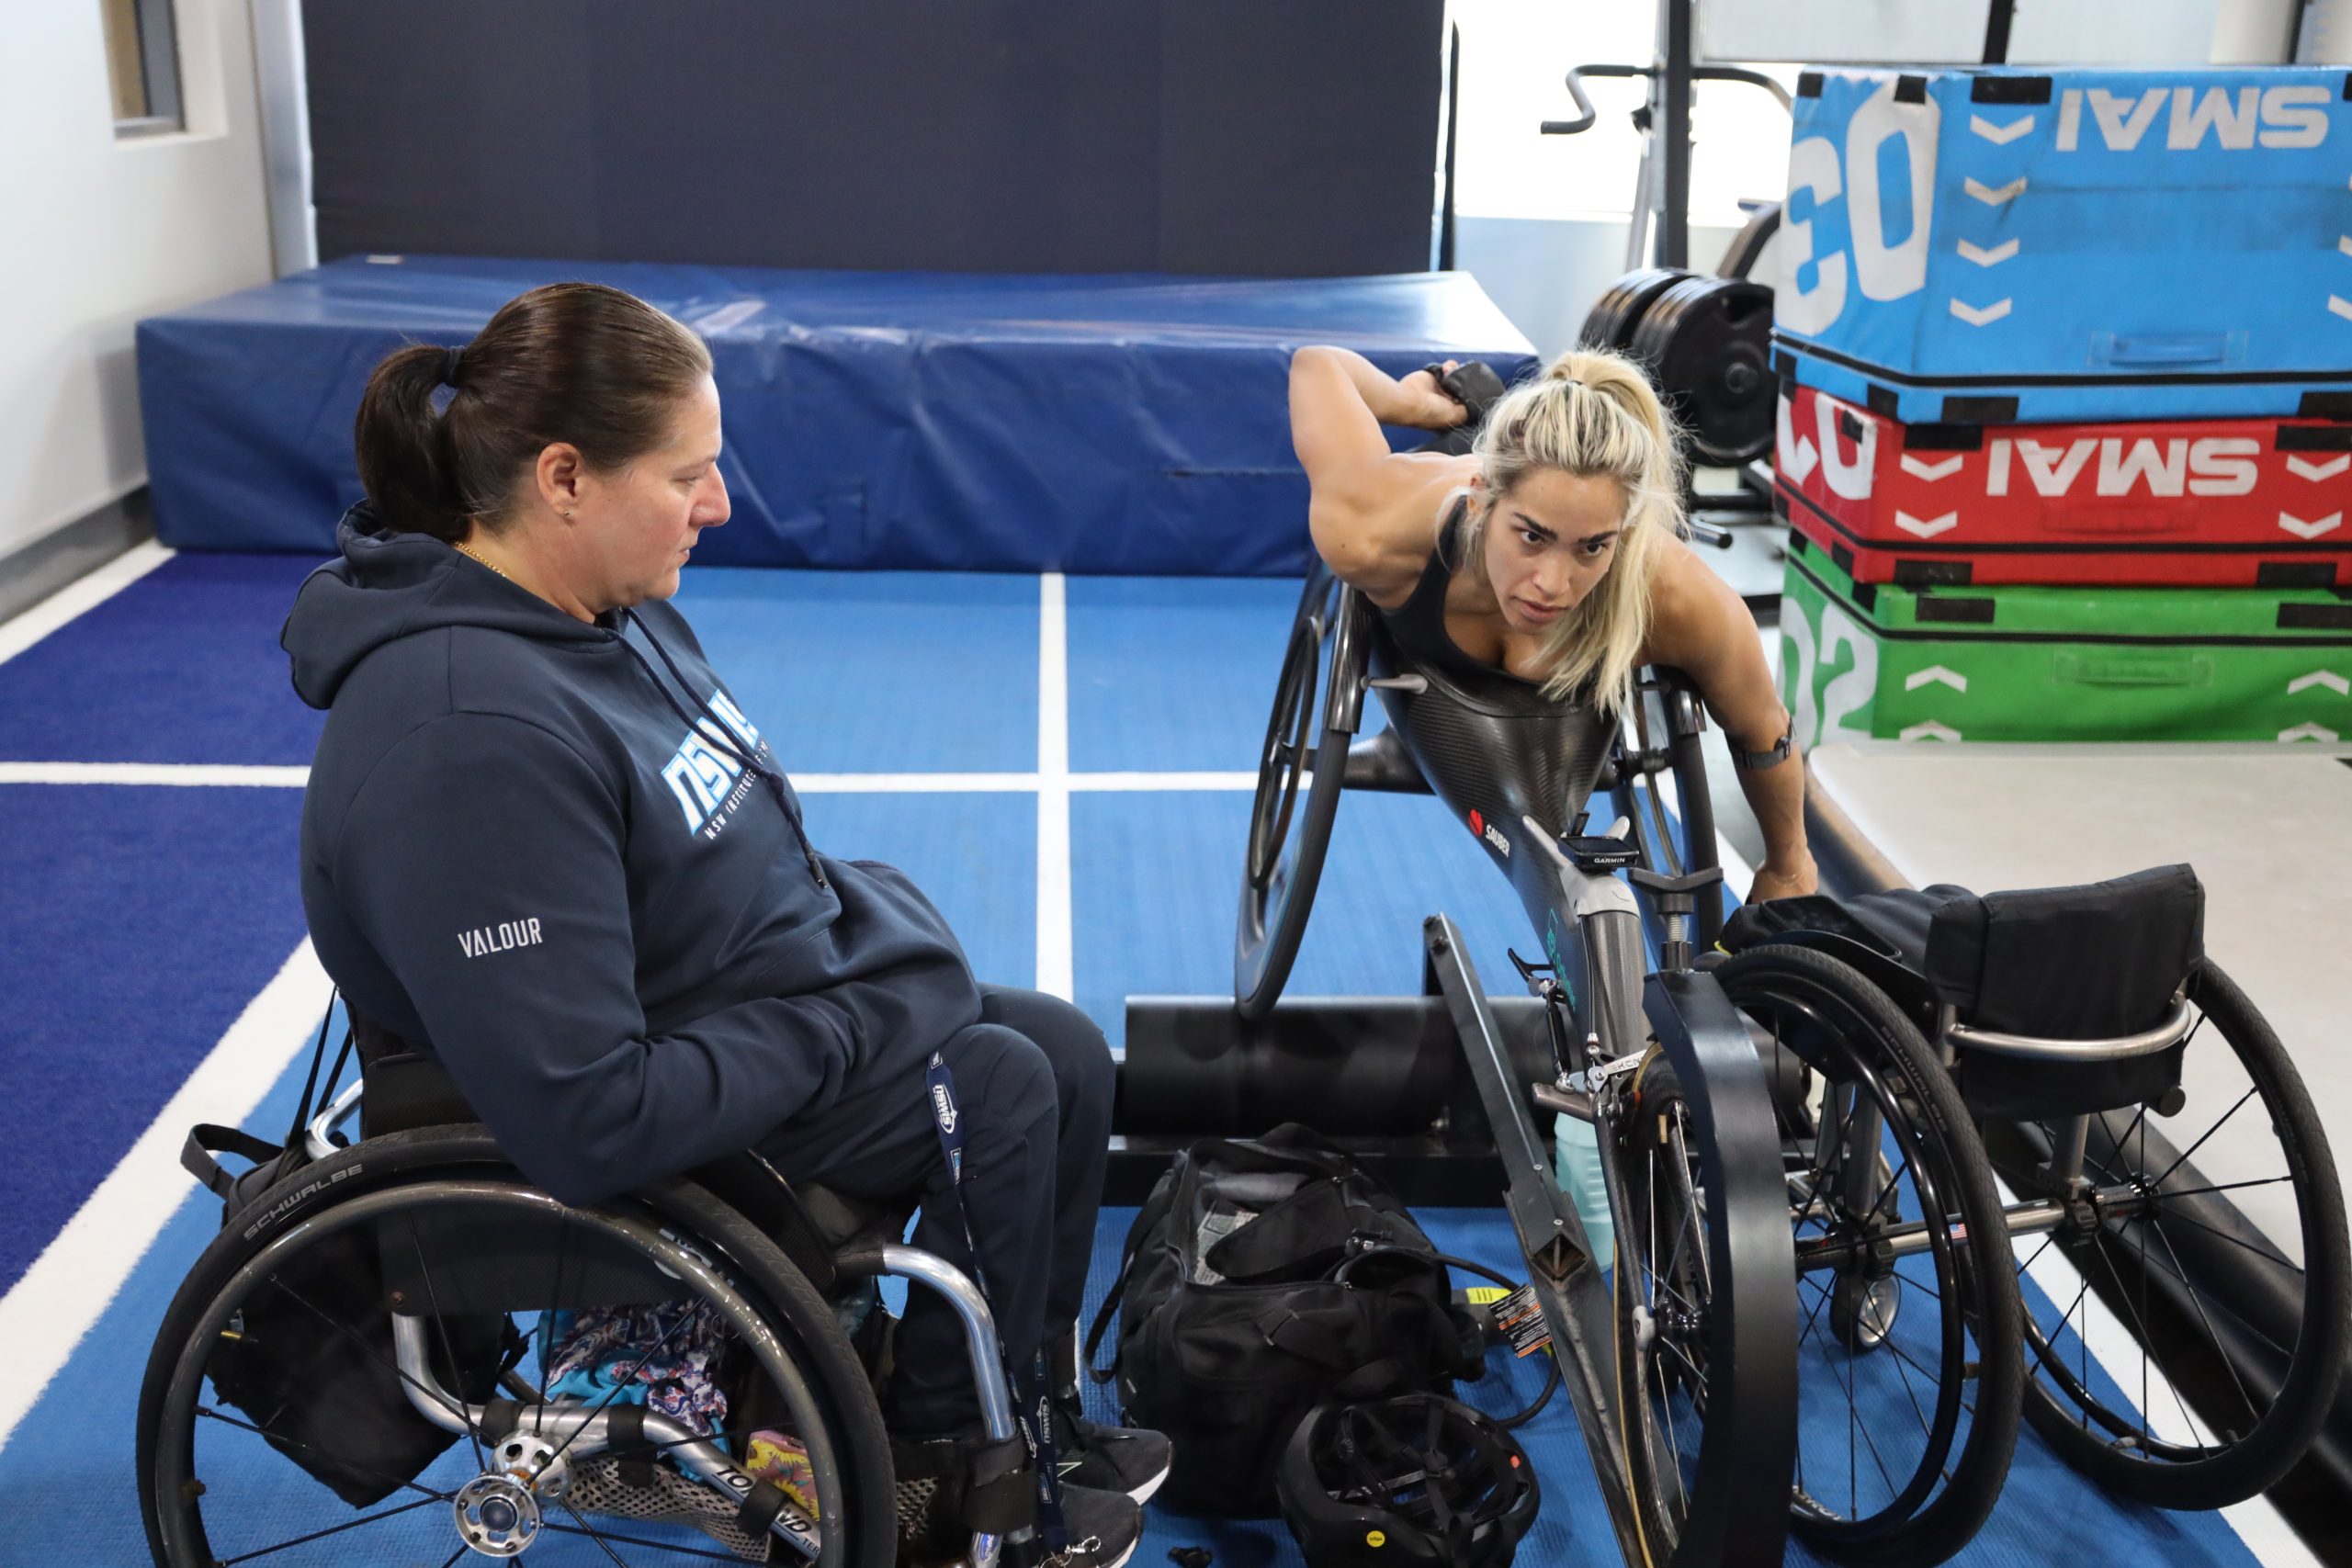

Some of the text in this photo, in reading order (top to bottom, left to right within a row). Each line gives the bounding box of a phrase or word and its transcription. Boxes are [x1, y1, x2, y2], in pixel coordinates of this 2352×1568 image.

[2055, 85, 2332, 152] SMAI
[1986, 437, 2261, 497] SMAI
[704, 813, 727, 840] NSW
[1485, 824, 1510, 858] SAUBER
[1594, 856, 1625, 864] GARMIN
[458, 918, 543, 958] VALOUR
[243, 1164, 365, 1242] SCHWALBE
[716, 1465, 753, 1495] TO
